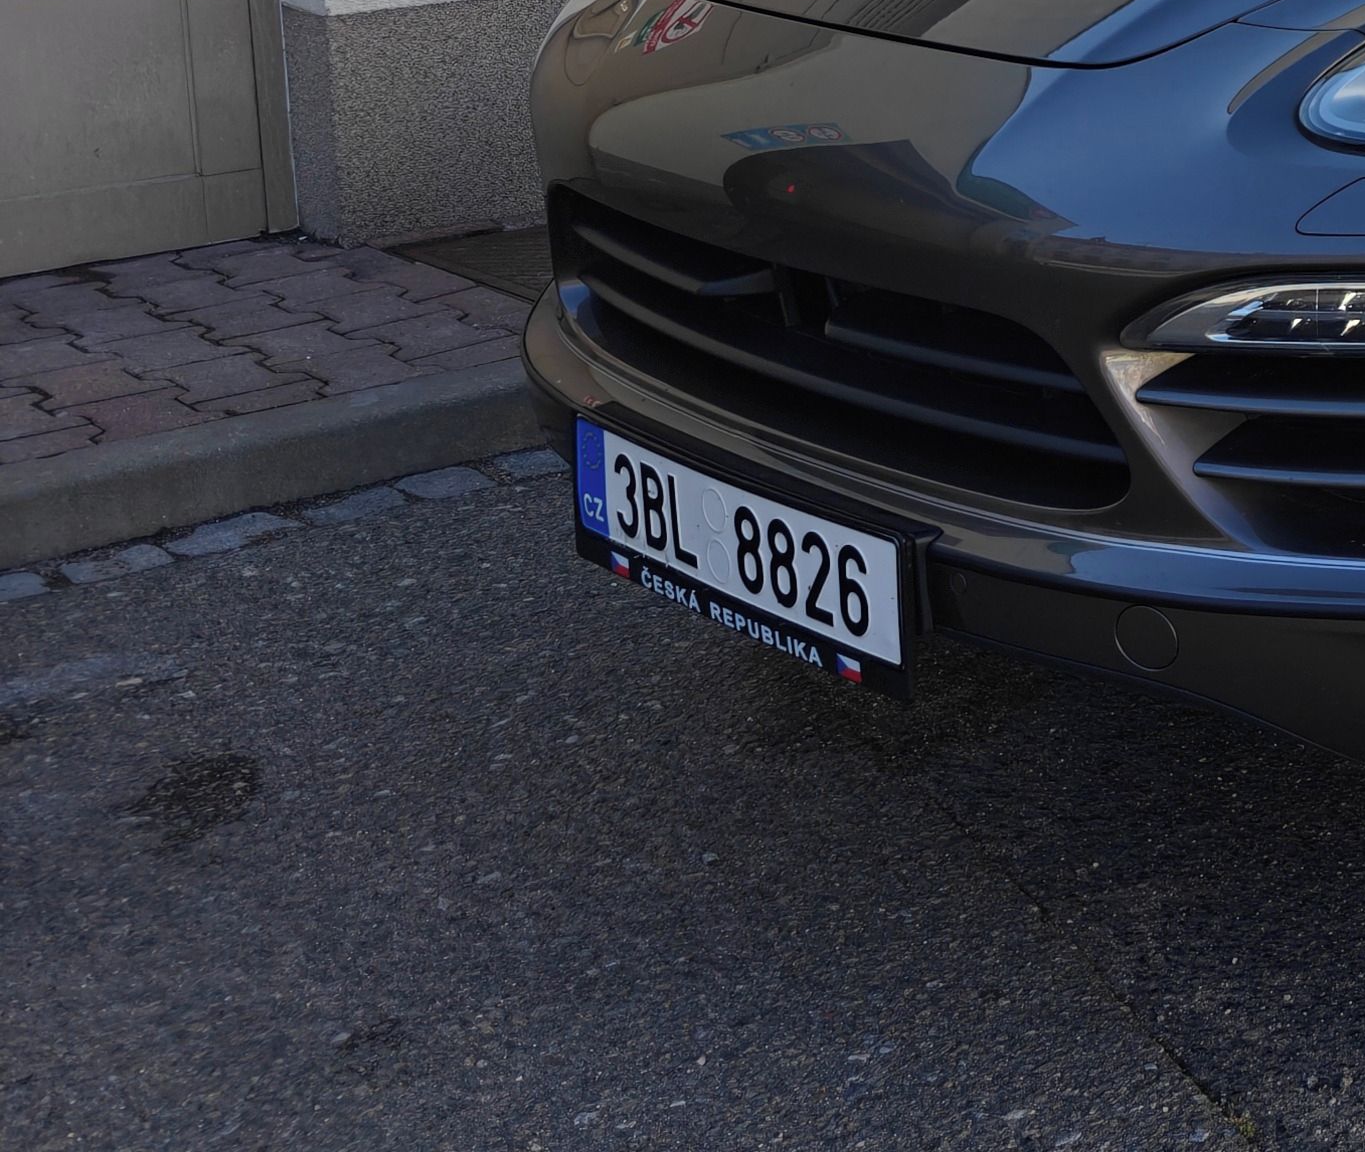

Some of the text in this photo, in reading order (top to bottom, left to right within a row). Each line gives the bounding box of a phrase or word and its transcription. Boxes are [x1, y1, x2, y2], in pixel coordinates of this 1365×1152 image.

[583, 493, 605, 523] CZ
[614, 453, 869, 638] 3BL 8826
[641, 567, 823, 668] ČESKÁ REPUBLIKA
